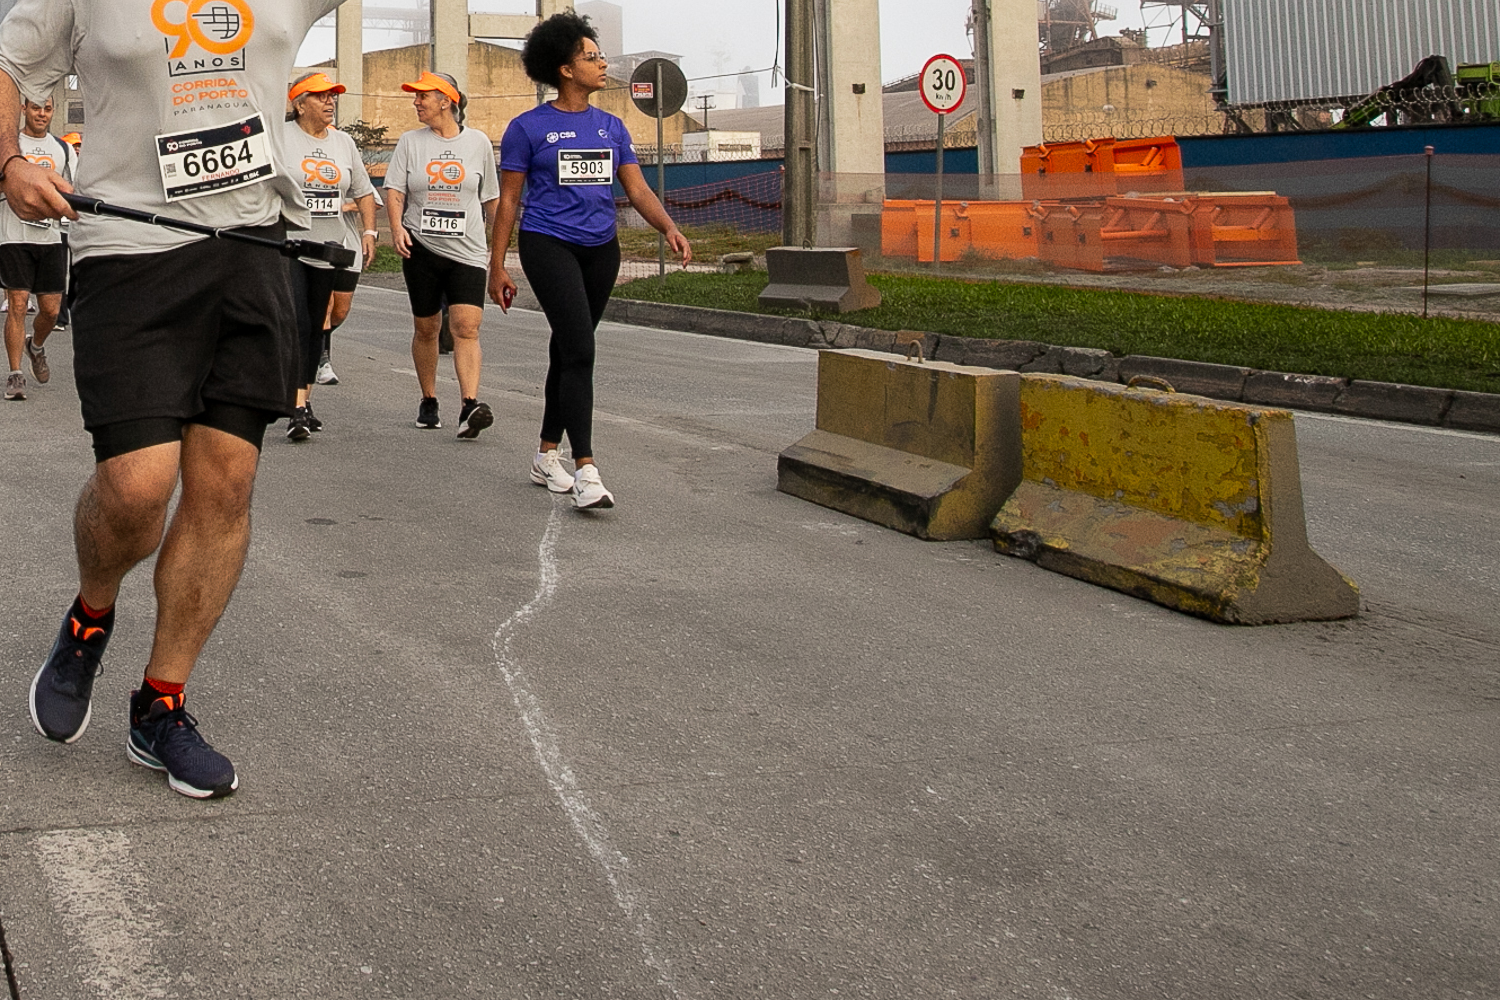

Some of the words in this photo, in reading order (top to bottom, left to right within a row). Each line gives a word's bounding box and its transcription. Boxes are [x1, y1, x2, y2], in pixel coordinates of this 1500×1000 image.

[175, 56, 240, 71] ANOS
[172, 78, 238, 94] CORRIDA
[932, 68, 956, 91] 30
[173, 94, 195, 106] DO
[198, 88, 249, 101] PORTO
[183, 139, 253, 177] 6664
[201, 168, 240, 182] FERNANDO
[301, 158, 342, 185] 90
[426, 161, 465, 185] 90
[571, 161, 603, 175] 5903
[306, 198, 333, 209] 6114
[430, 217, 457, 229] 6116
